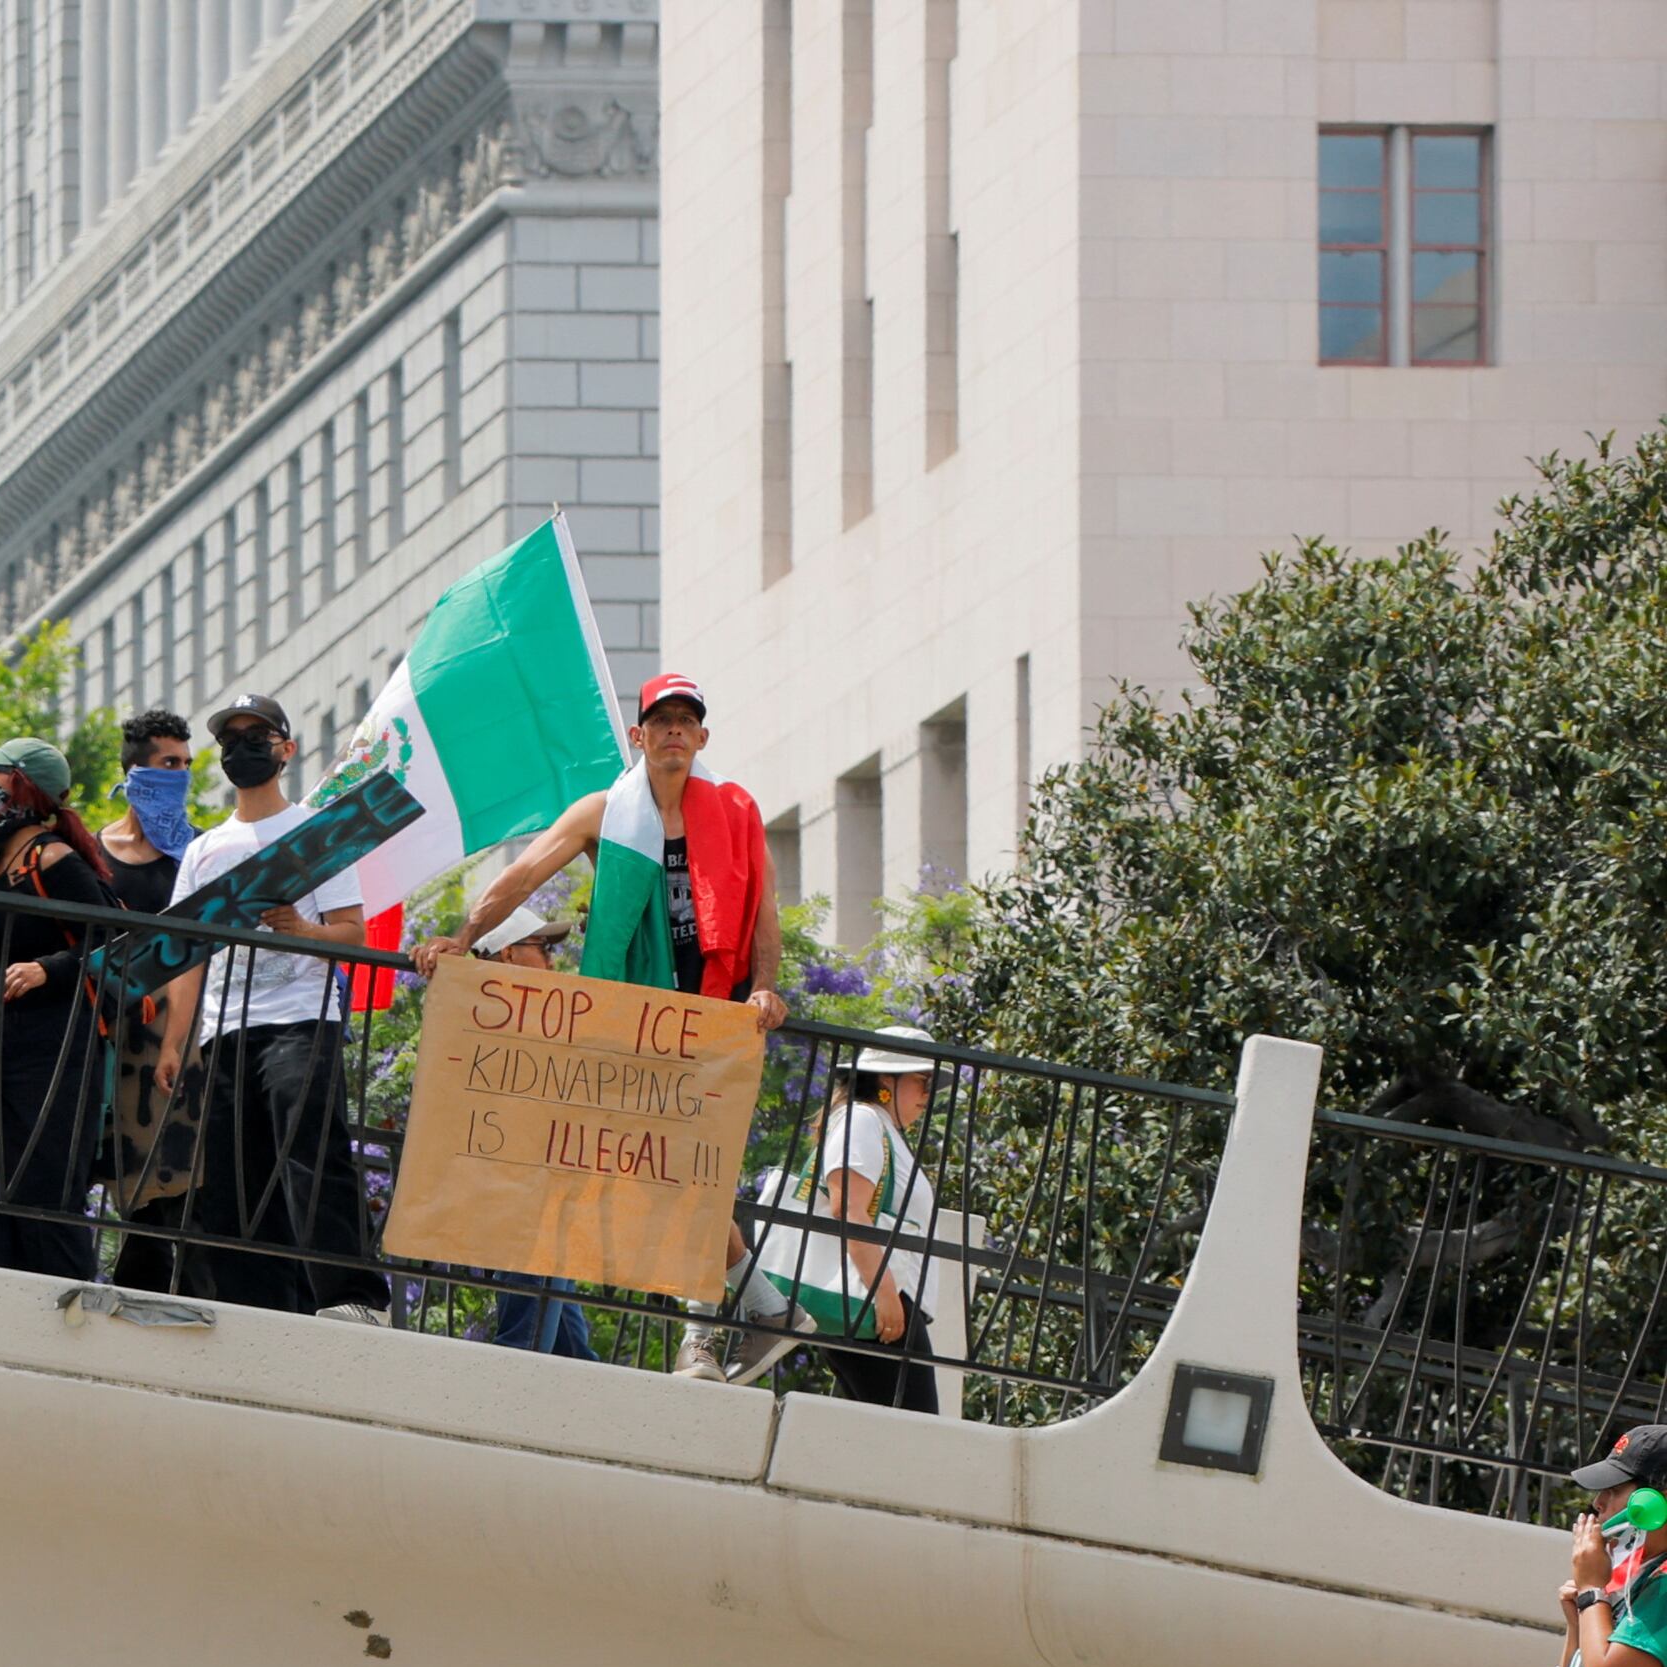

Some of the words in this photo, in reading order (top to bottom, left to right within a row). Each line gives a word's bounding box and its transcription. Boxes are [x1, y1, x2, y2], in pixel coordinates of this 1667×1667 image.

[472, 979, 593, 1044] STOP
[635, 1001, 703, 1060] ICE
[466, 1109, 505, 1155] IS
[545, 1119, 681, 1184] ILLEGAL
